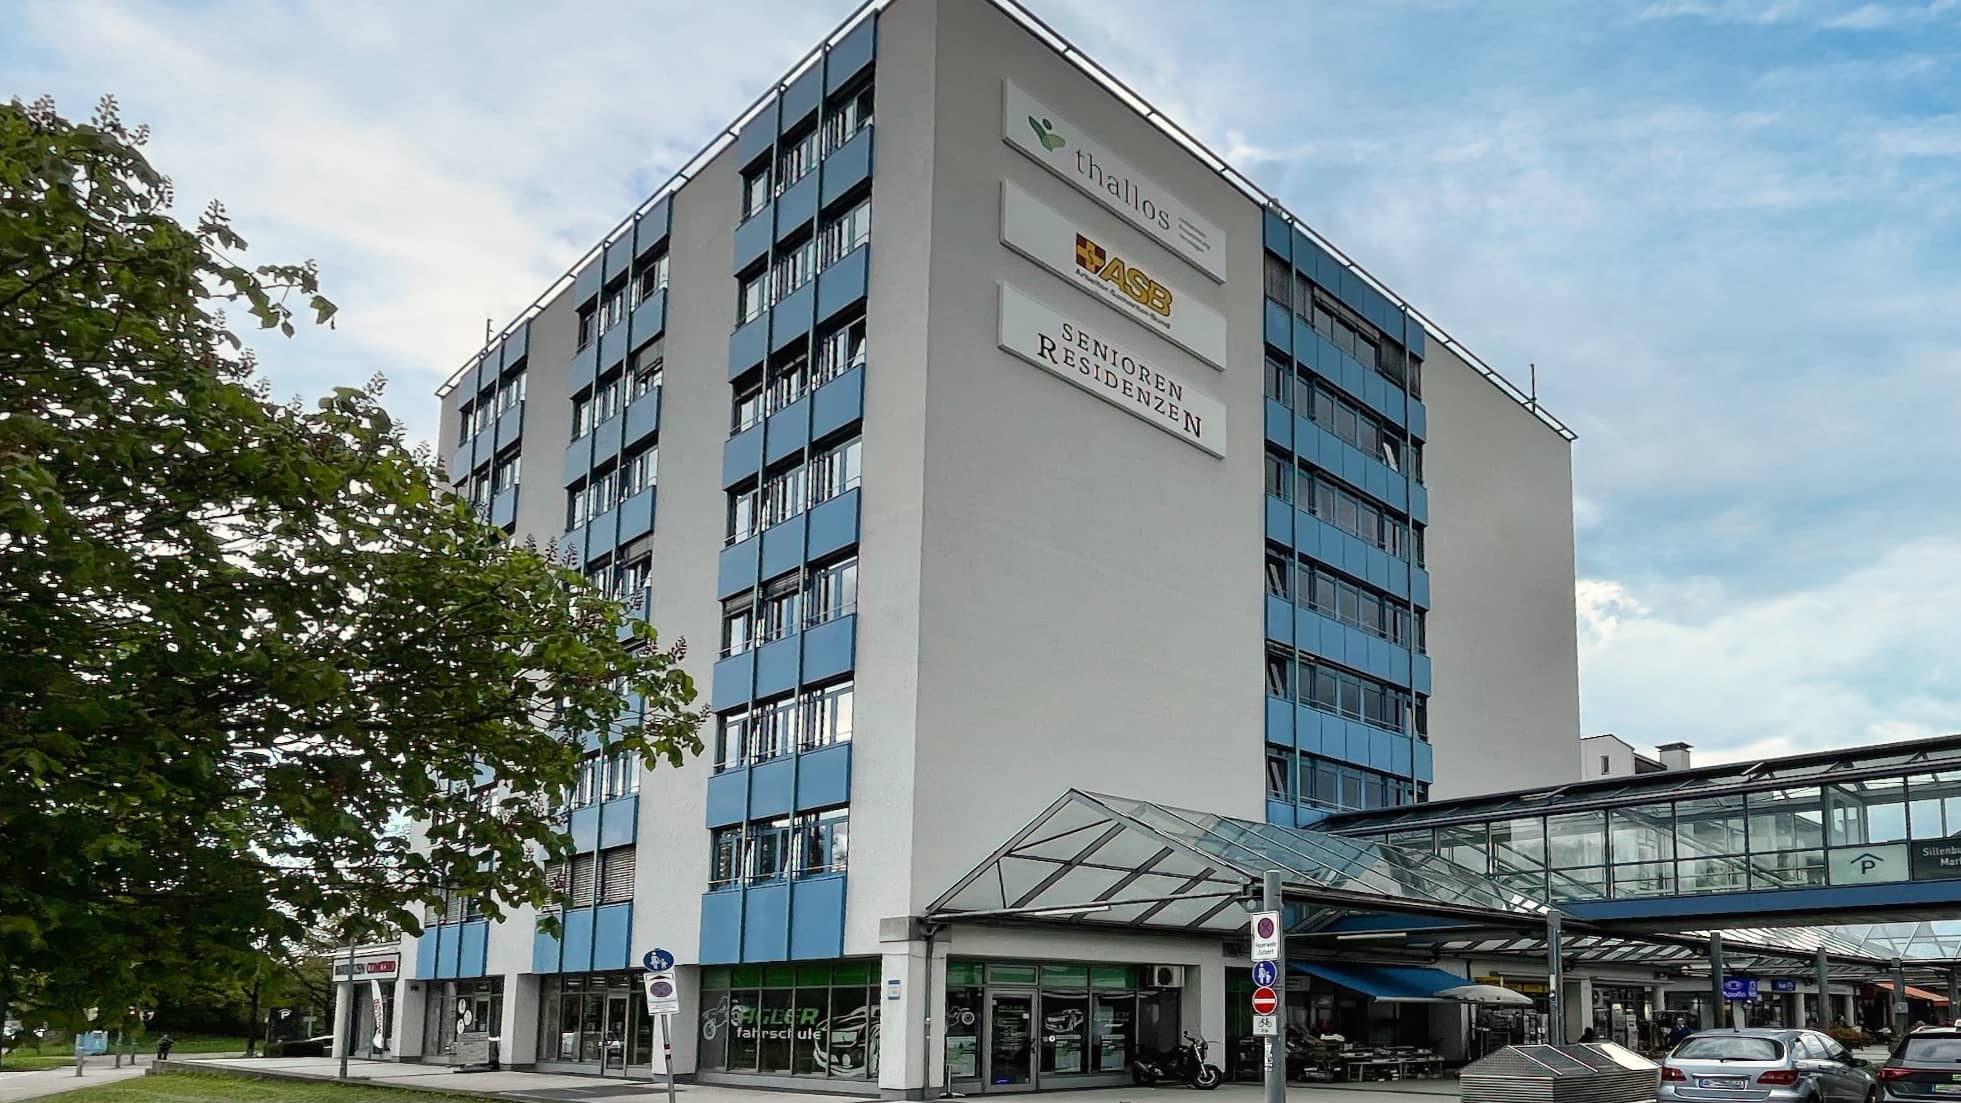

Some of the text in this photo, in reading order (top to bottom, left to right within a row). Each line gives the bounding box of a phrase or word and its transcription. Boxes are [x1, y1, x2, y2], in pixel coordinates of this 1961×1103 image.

[1075, 148, 1170, 230] thallos
[1098, 256, 1173, 317] ASB
[1037, 333, 1202, 438] RESIDENZEN
[1062, 323, 1183, 401] SENIOREN
[1861, 860, 1876, 874] P
[1940, 857, 1961, 867] Mar
[736, 1027, 823, 1040] fahrschule
